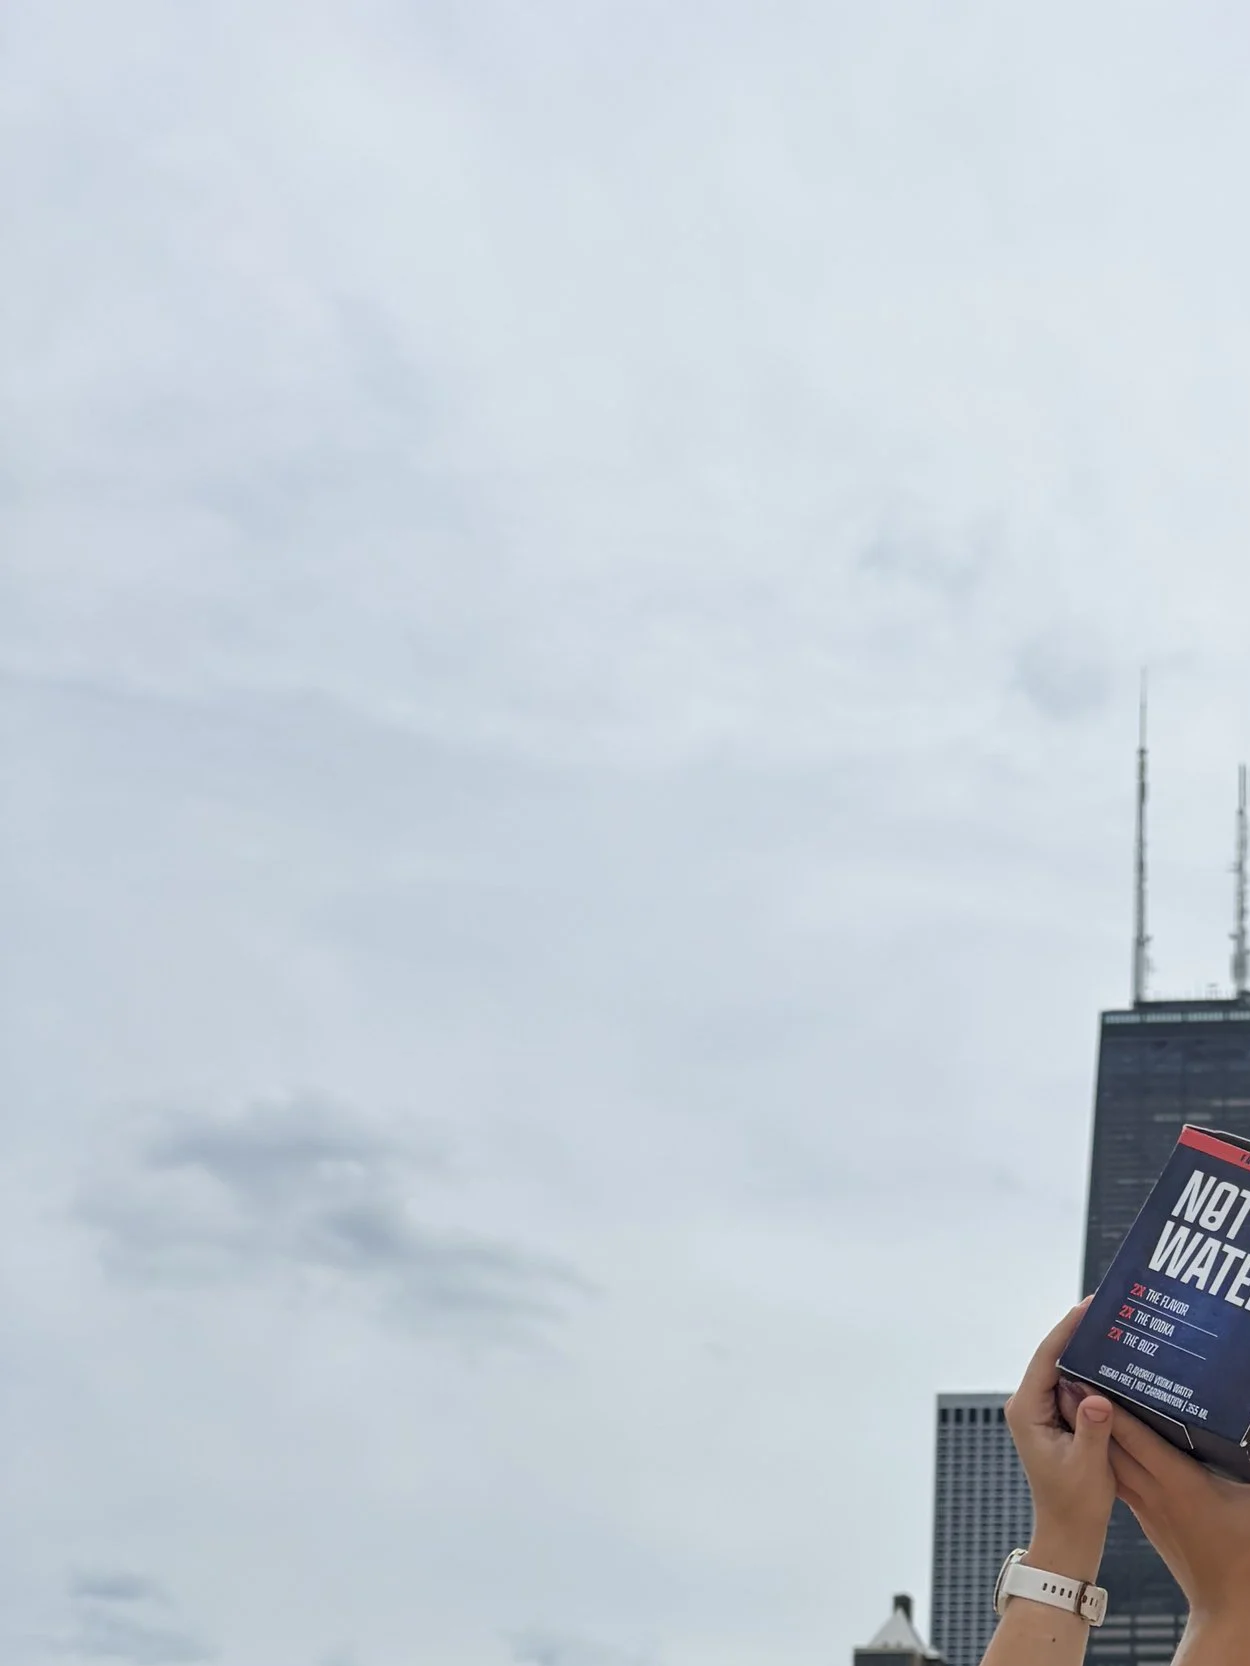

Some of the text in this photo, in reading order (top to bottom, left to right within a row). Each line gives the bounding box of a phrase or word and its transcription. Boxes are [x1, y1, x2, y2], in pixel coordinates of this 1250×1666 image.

[1130, 1283, 1190, 1317] 2X THE FLAVOR
[1119, 1305, 1176, 1338] 2X THE VODKA
[1107, 1327, 1160, 1357] 2X THE BUZZ
[1098, 1365, 1119, 1380] SUGAR
[1117, 1372, 1134, 1387] FREE
[1135, 1380, 1145, 1393] NO
[1145, 1384, 1183, 1409] CARBONATION
[1186, 1403, 1199, 1415] 355
[1125, 1363, 1194, 1399] FLAVORED VODKA WATER
